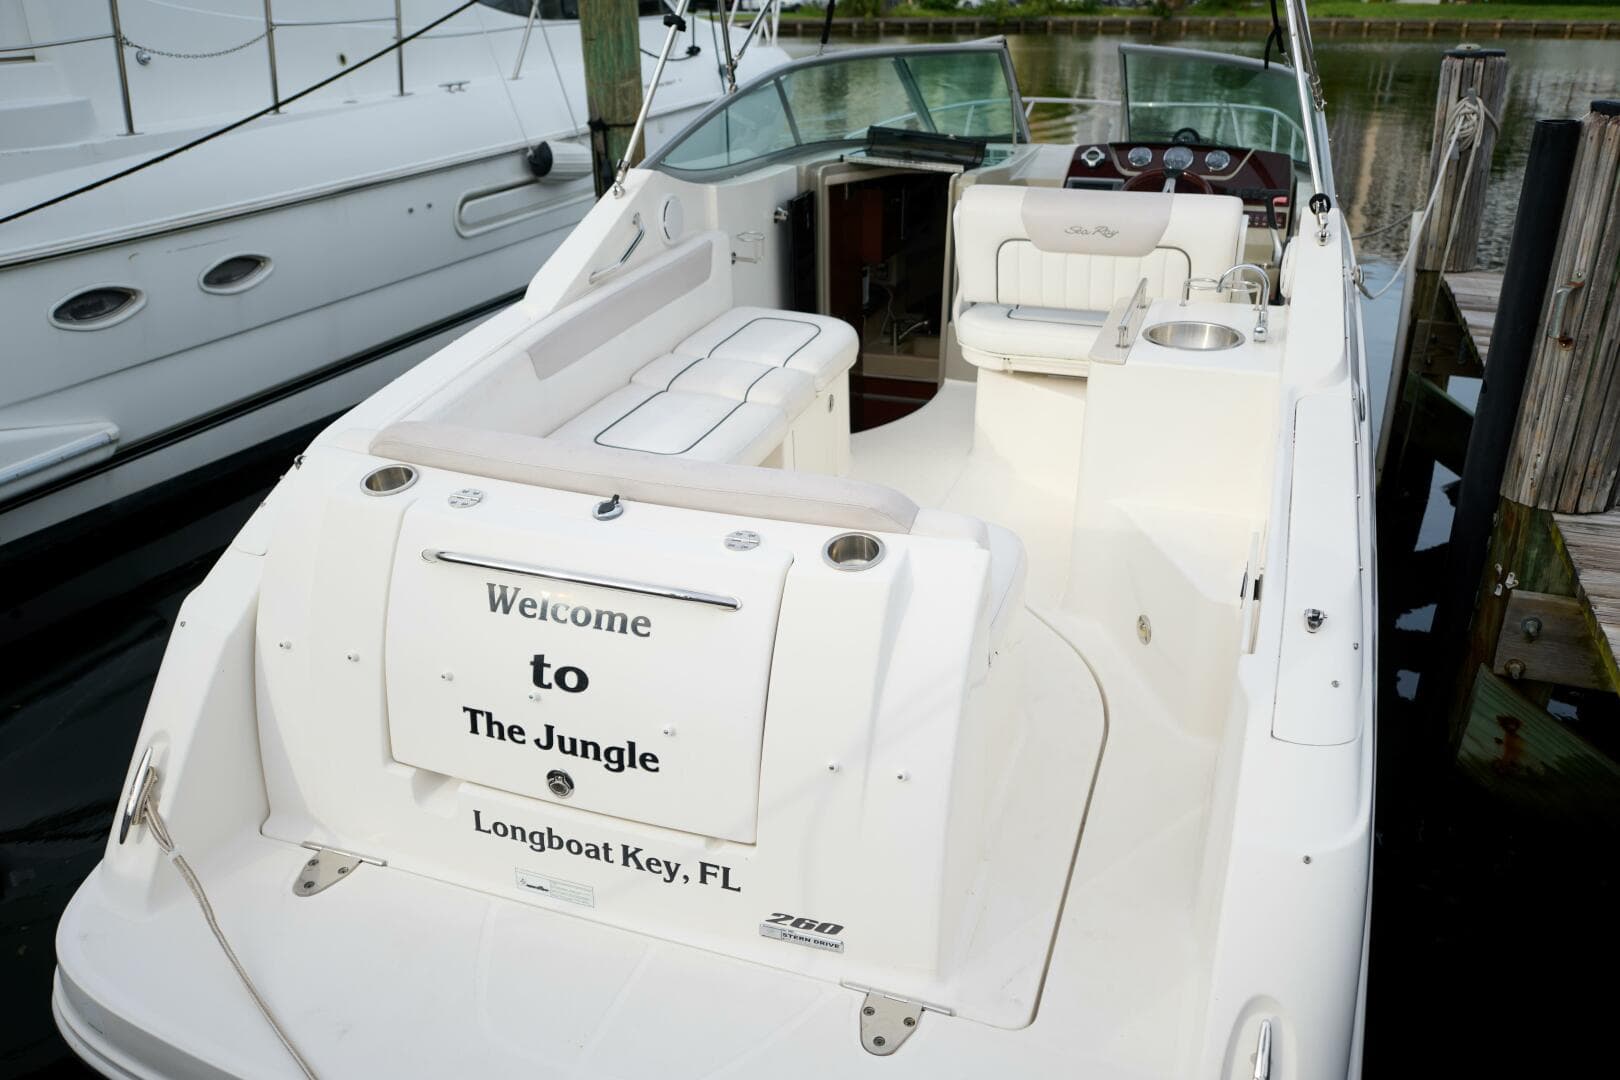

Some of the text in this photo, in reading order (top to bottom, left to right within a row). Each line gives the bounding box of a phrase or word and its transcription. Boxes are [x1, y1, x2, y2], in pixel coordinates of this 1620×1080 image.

[1064, 225, 1119, 239] Sea Ray
[486, 582, 651, 638] Welcome
[529, 653, 590, 693] to
[462, 706, 661, 773] The Jungle
[472, 809, 742, 893] Longboat Key, FL
[765, 912, 844, 935] 260
[782, 932, 840, 949] STERN DRIVE
